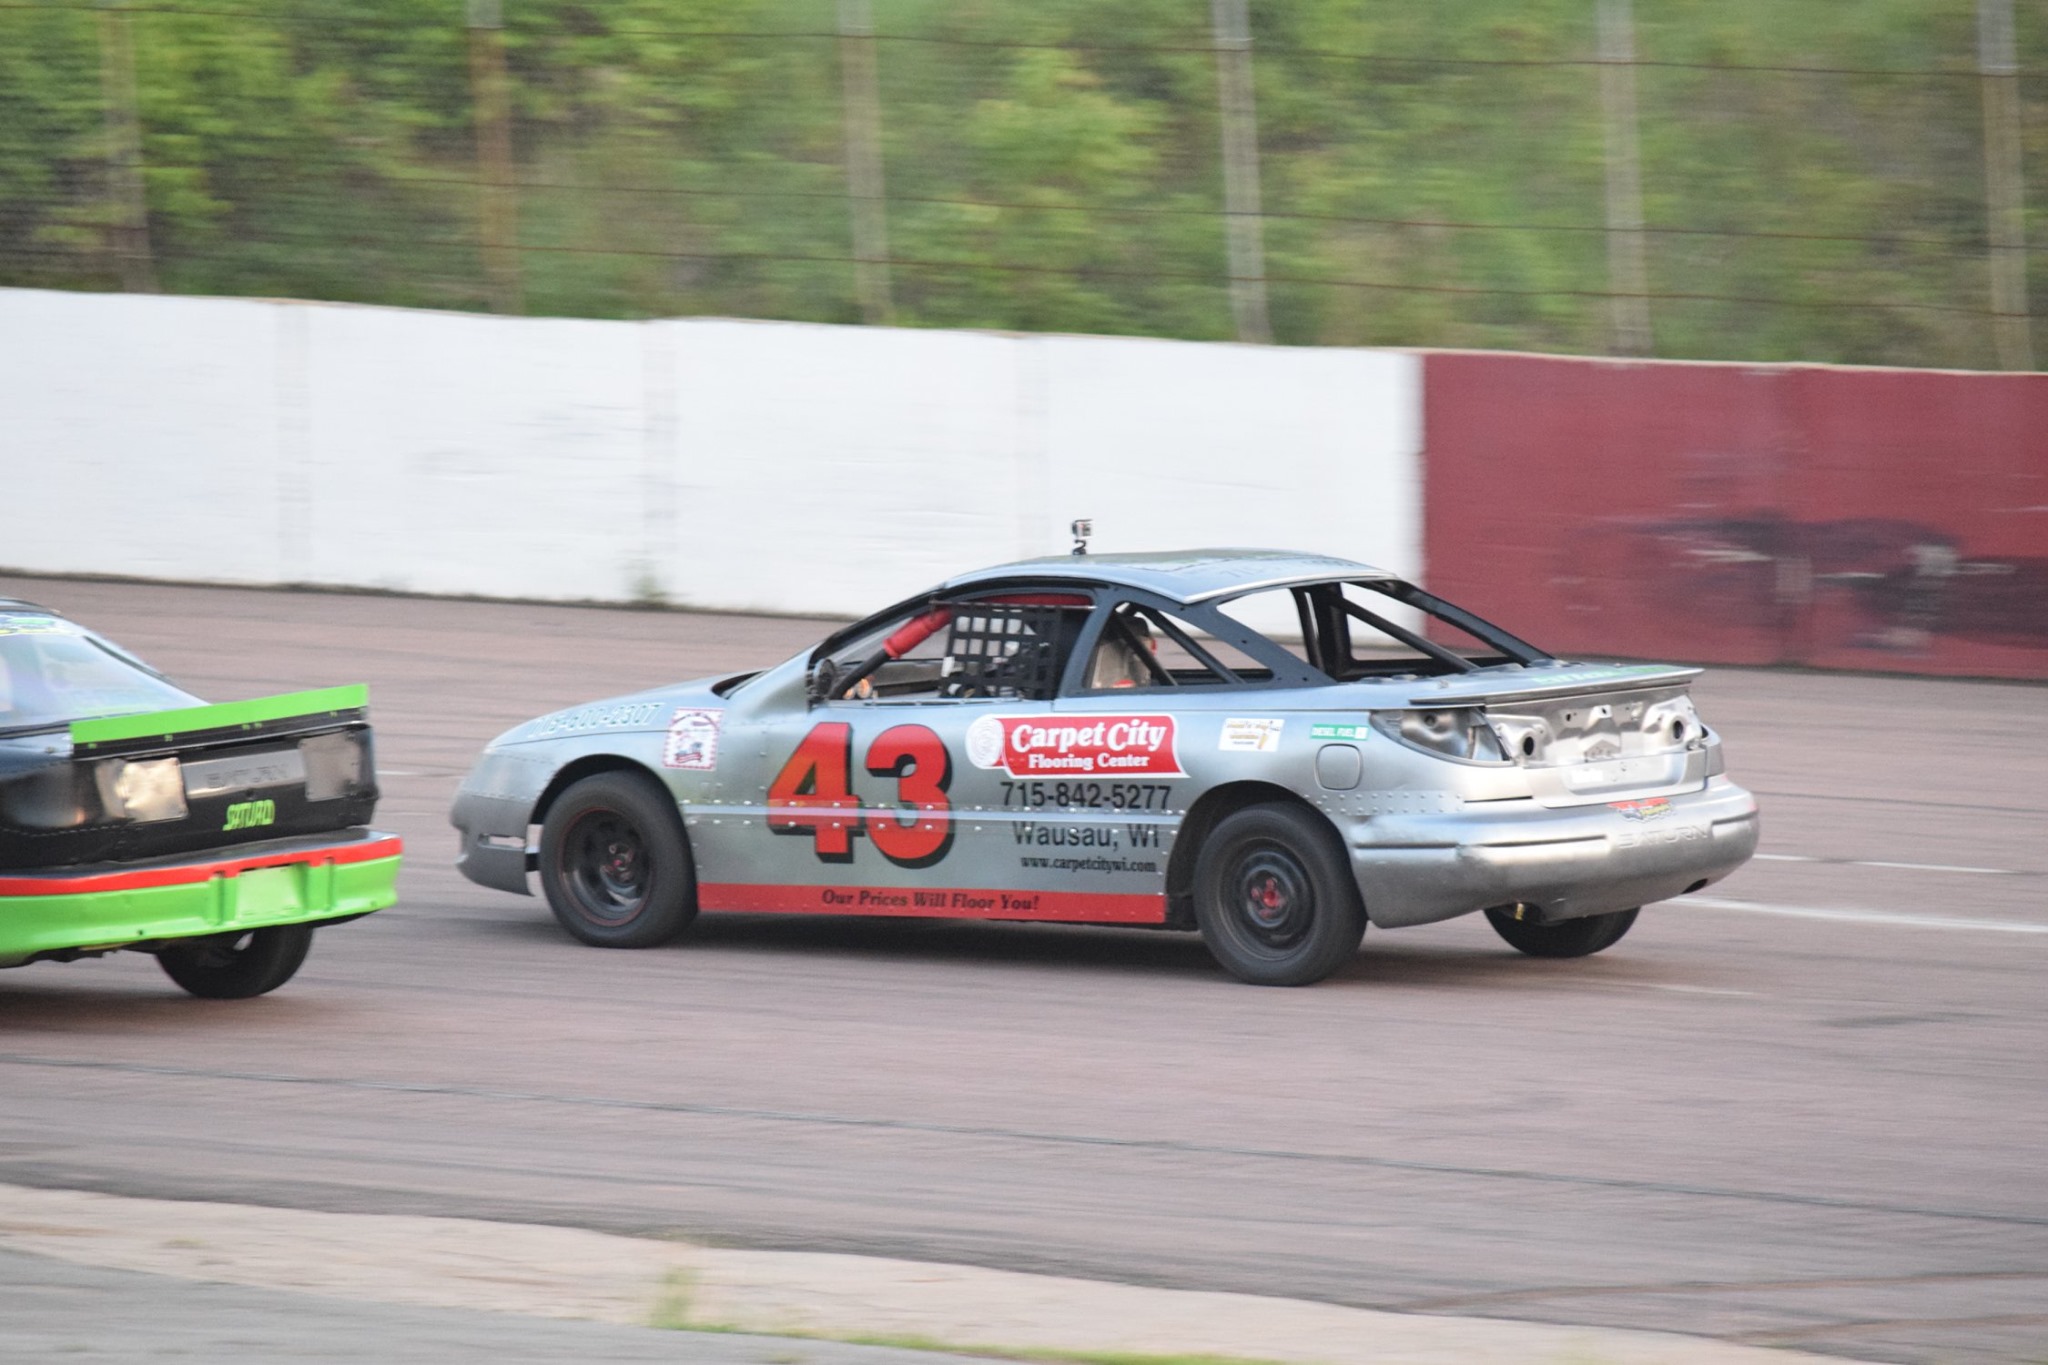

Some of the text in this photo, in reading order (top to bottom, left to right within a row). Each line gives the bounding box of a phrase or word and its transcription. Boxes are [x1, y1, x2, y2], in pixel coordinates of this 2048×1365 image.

[1011, 718, 1167, 753] Carpet City
[1028, 752, 1149, 770] Flooring Center
[767, 722, 955, 869] 43
[1000, 781, 1172, 809] 715-842-5277
[1013, 820, 1159, 851] Wausau, WI
[1020, 855, 1157, 874] www.carpetcitywi.com
[822, 889, 1040, 910] Our Prices Will Floor You!
